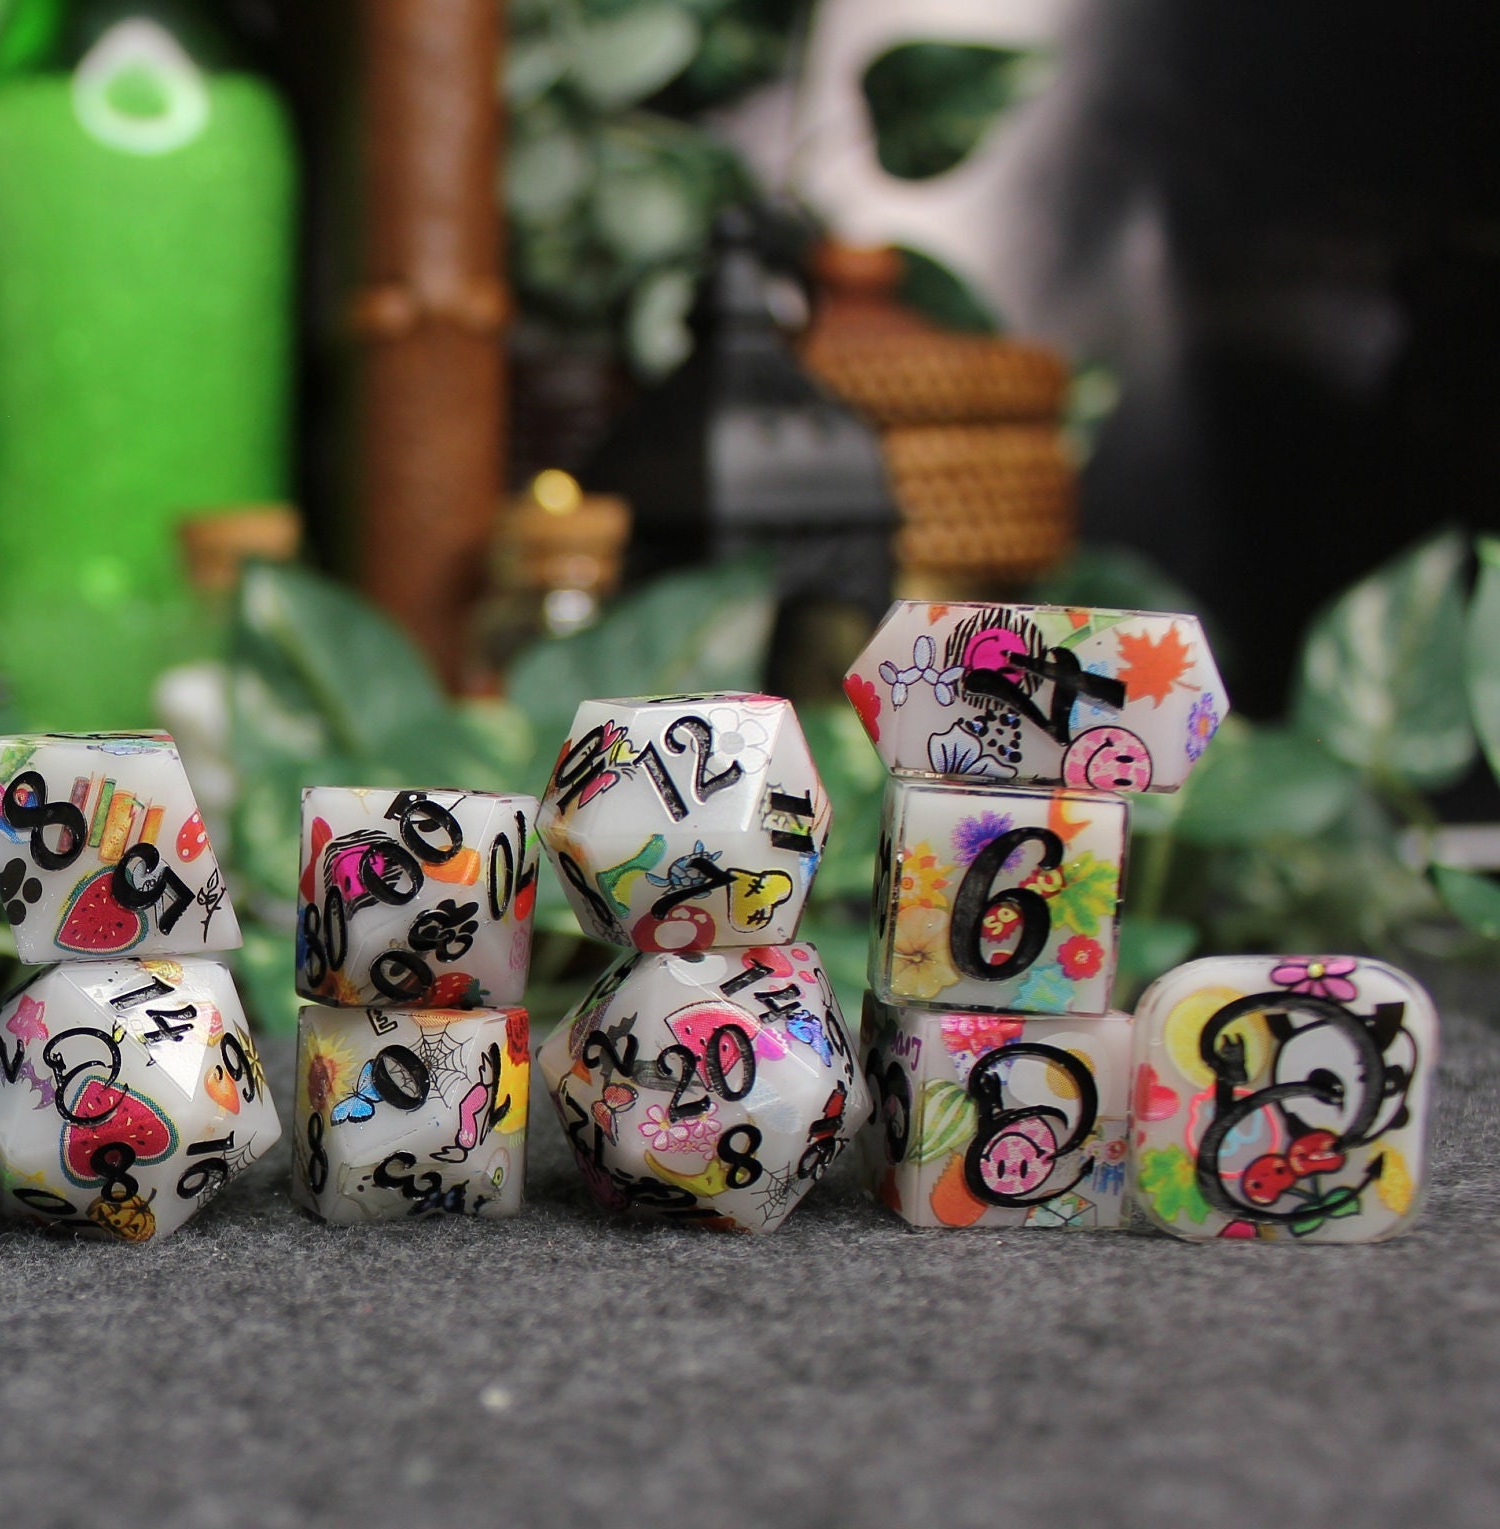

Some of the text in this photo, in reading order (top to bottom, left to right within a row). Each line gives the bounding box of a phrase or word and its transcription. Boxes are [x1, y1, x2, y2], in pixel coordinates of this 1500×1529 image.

[633, 714, 744, 825] 12
[2, 770, 88, 872] 8
[357, 799, 464, 907] 00
[952, 827, 1064, 983] 6
[371, 1043, 431, 1111] 0
[582, 1029, 639, 1077] 2
[656, 1023, 757, 1124] 20
[89, 1141, 140, 1204] 8
[716, 1123, 763, 1189] 8
